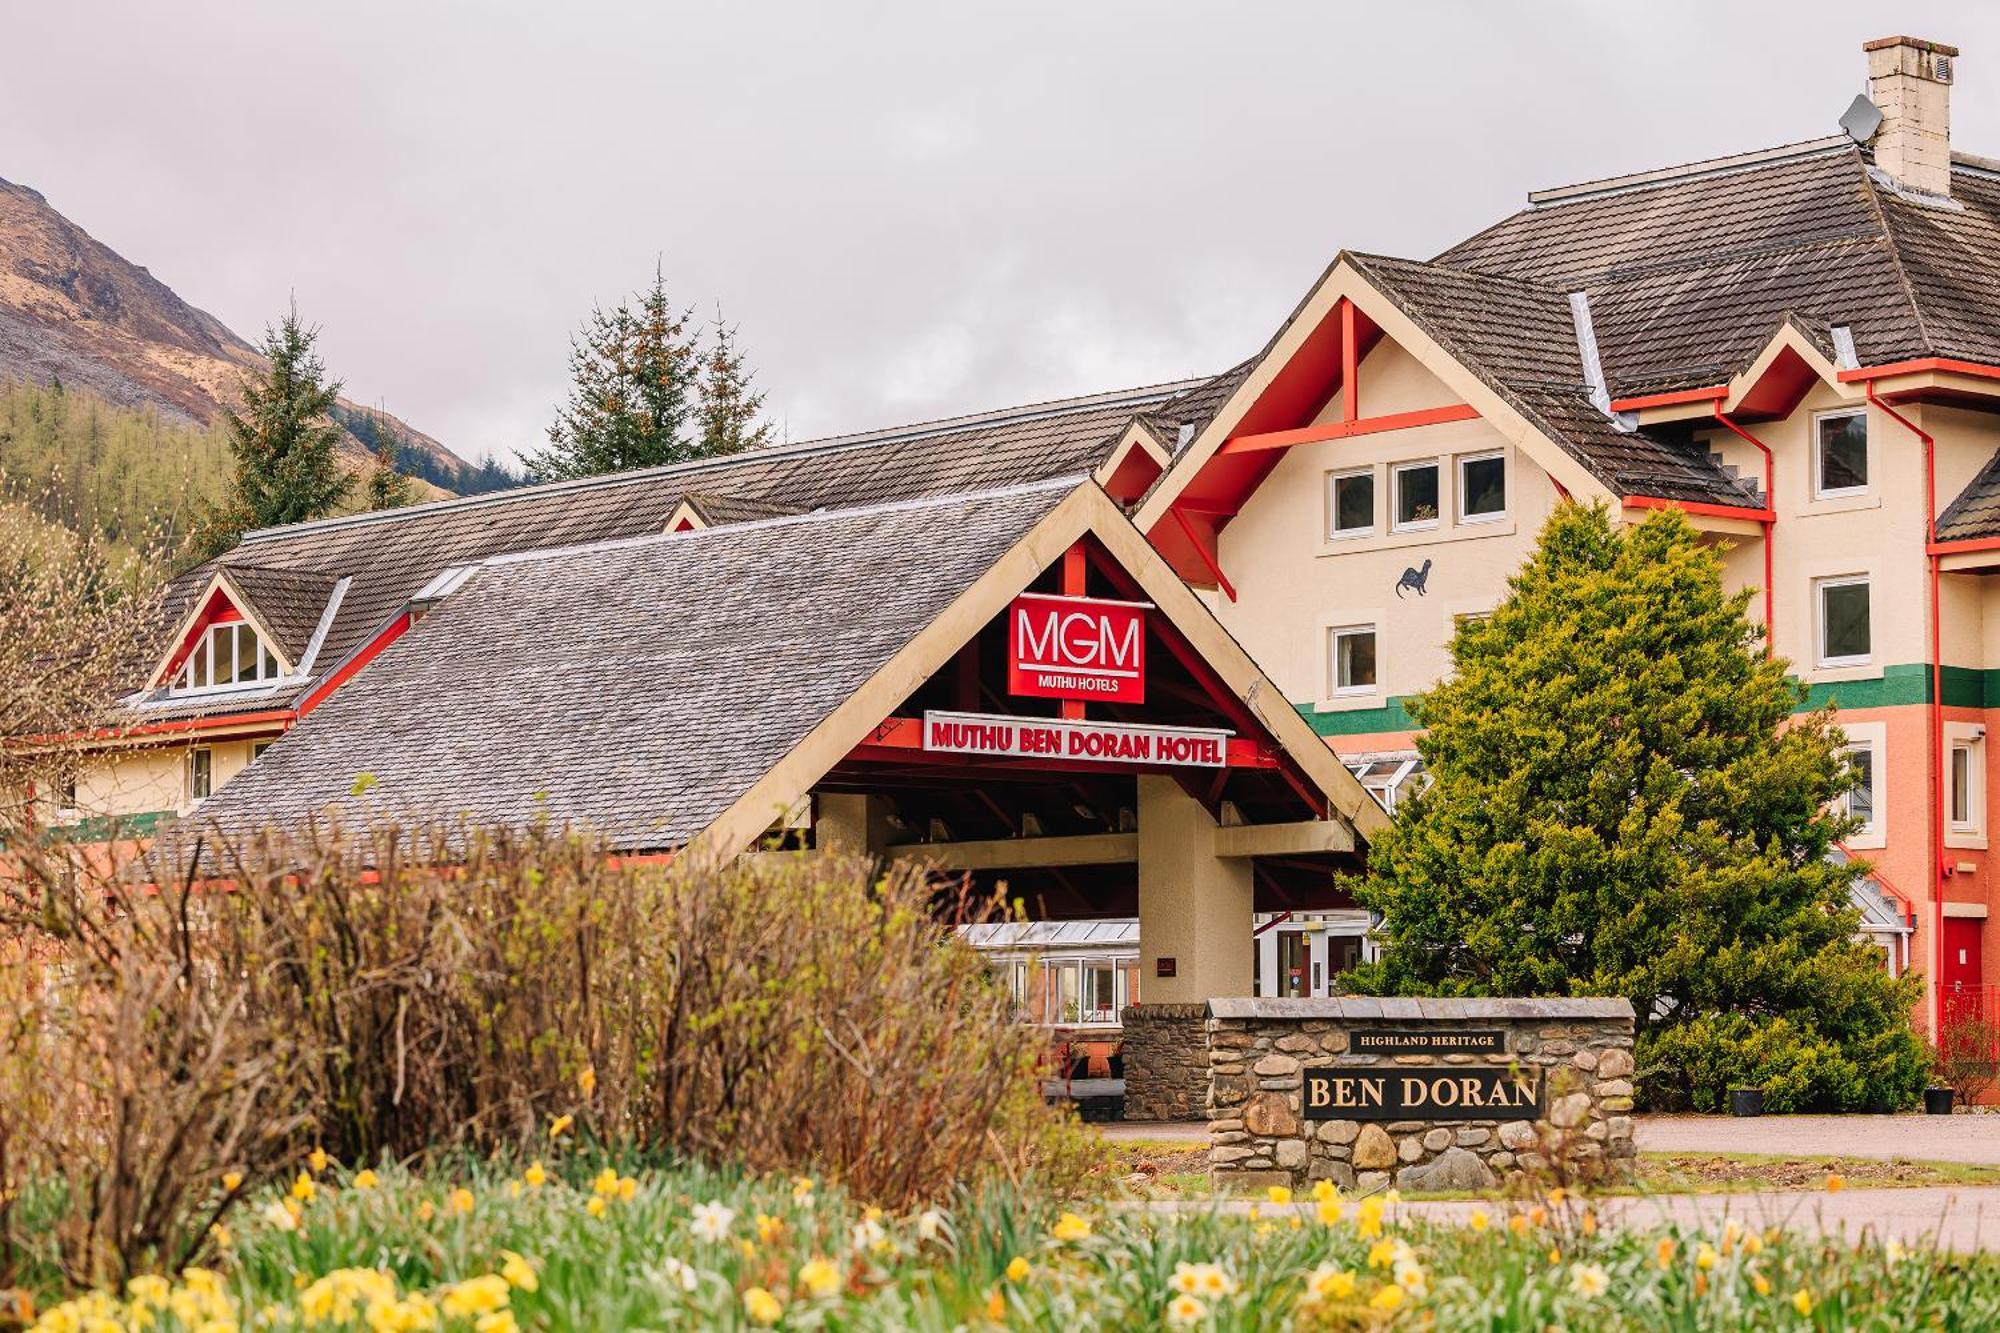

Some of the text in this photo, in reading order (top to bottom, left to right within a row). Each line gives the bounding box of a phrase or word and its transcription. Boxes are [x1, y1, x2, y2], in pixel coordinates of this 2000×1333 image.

[1018, 609, 1139, 668] MGM
[1038, 675, 1119, 692] MUTHU HOTELS
[931, 722, 1222, 763] MUTHU BEN DORAN HOTEL
[1360, 1036, 1495, 1046] HIGHLAND HERITAGE
[1309, 1077, 1539, 1107] BEN DORAN
